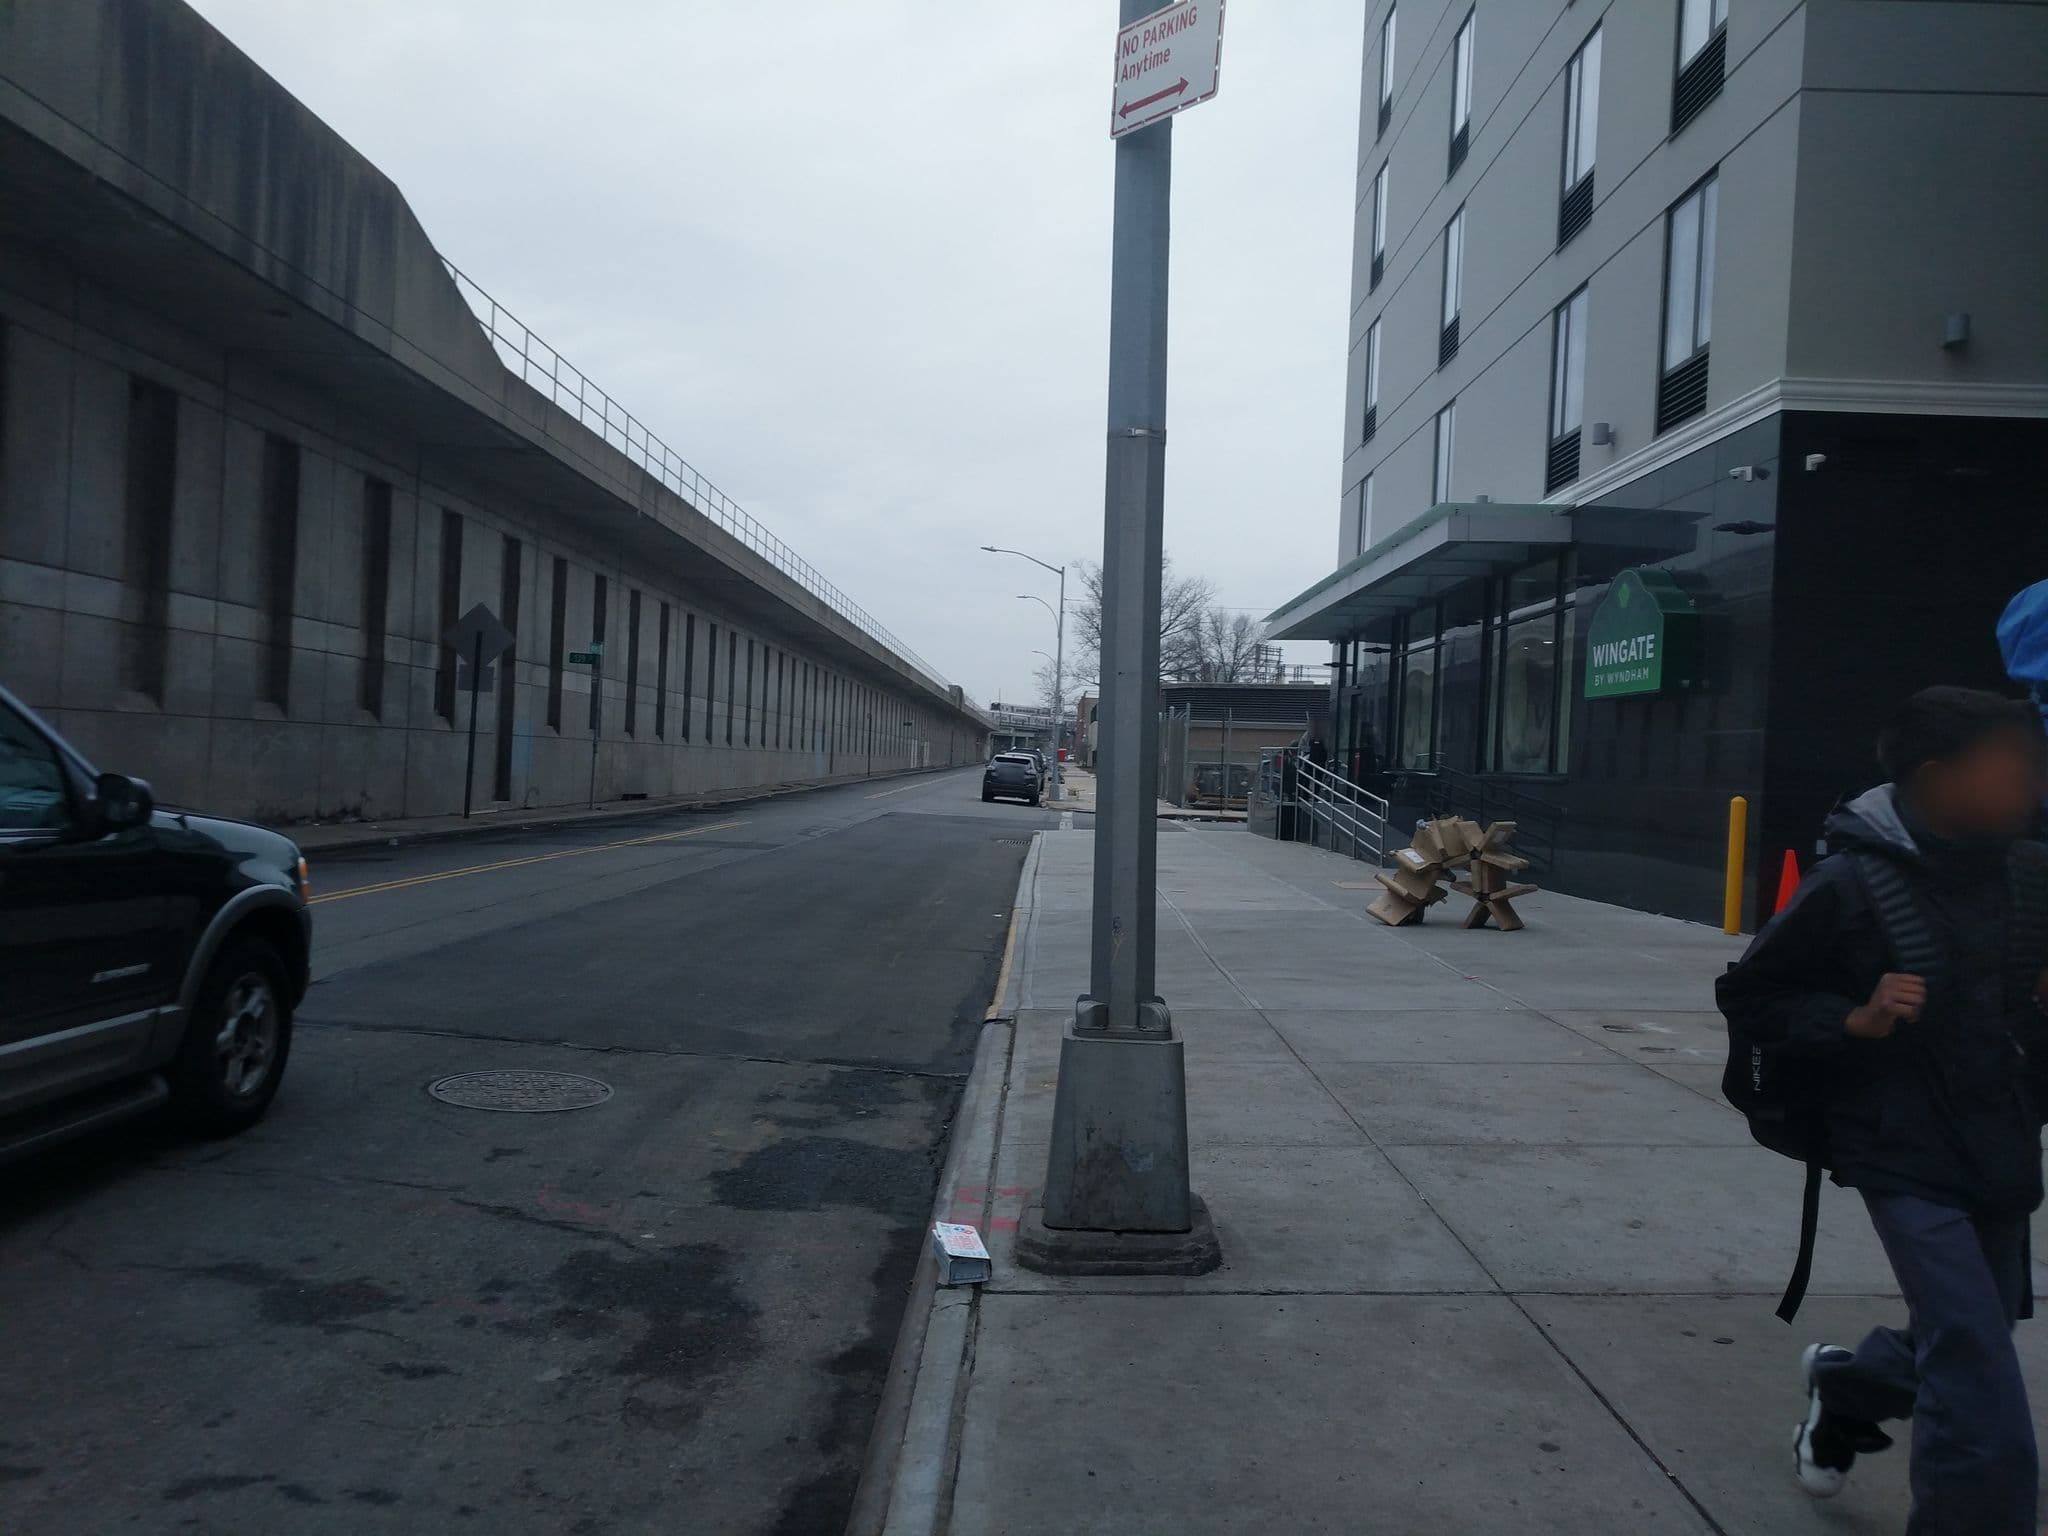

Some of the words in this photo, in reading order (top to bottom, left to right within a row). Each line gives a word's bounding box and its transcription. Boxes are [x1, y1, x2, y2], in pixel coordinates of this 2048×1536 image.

[1122, 35, 1139, 60] NO
[1143, 6, 1198, 49] PARKING
[1120, 47, 1171, 83] Anytime
[1592, 634, 1656, 668] WINGATE
[1594, 673, 1605, 687] BY
[1607, 667, 1649, 685] WYNDHAM
